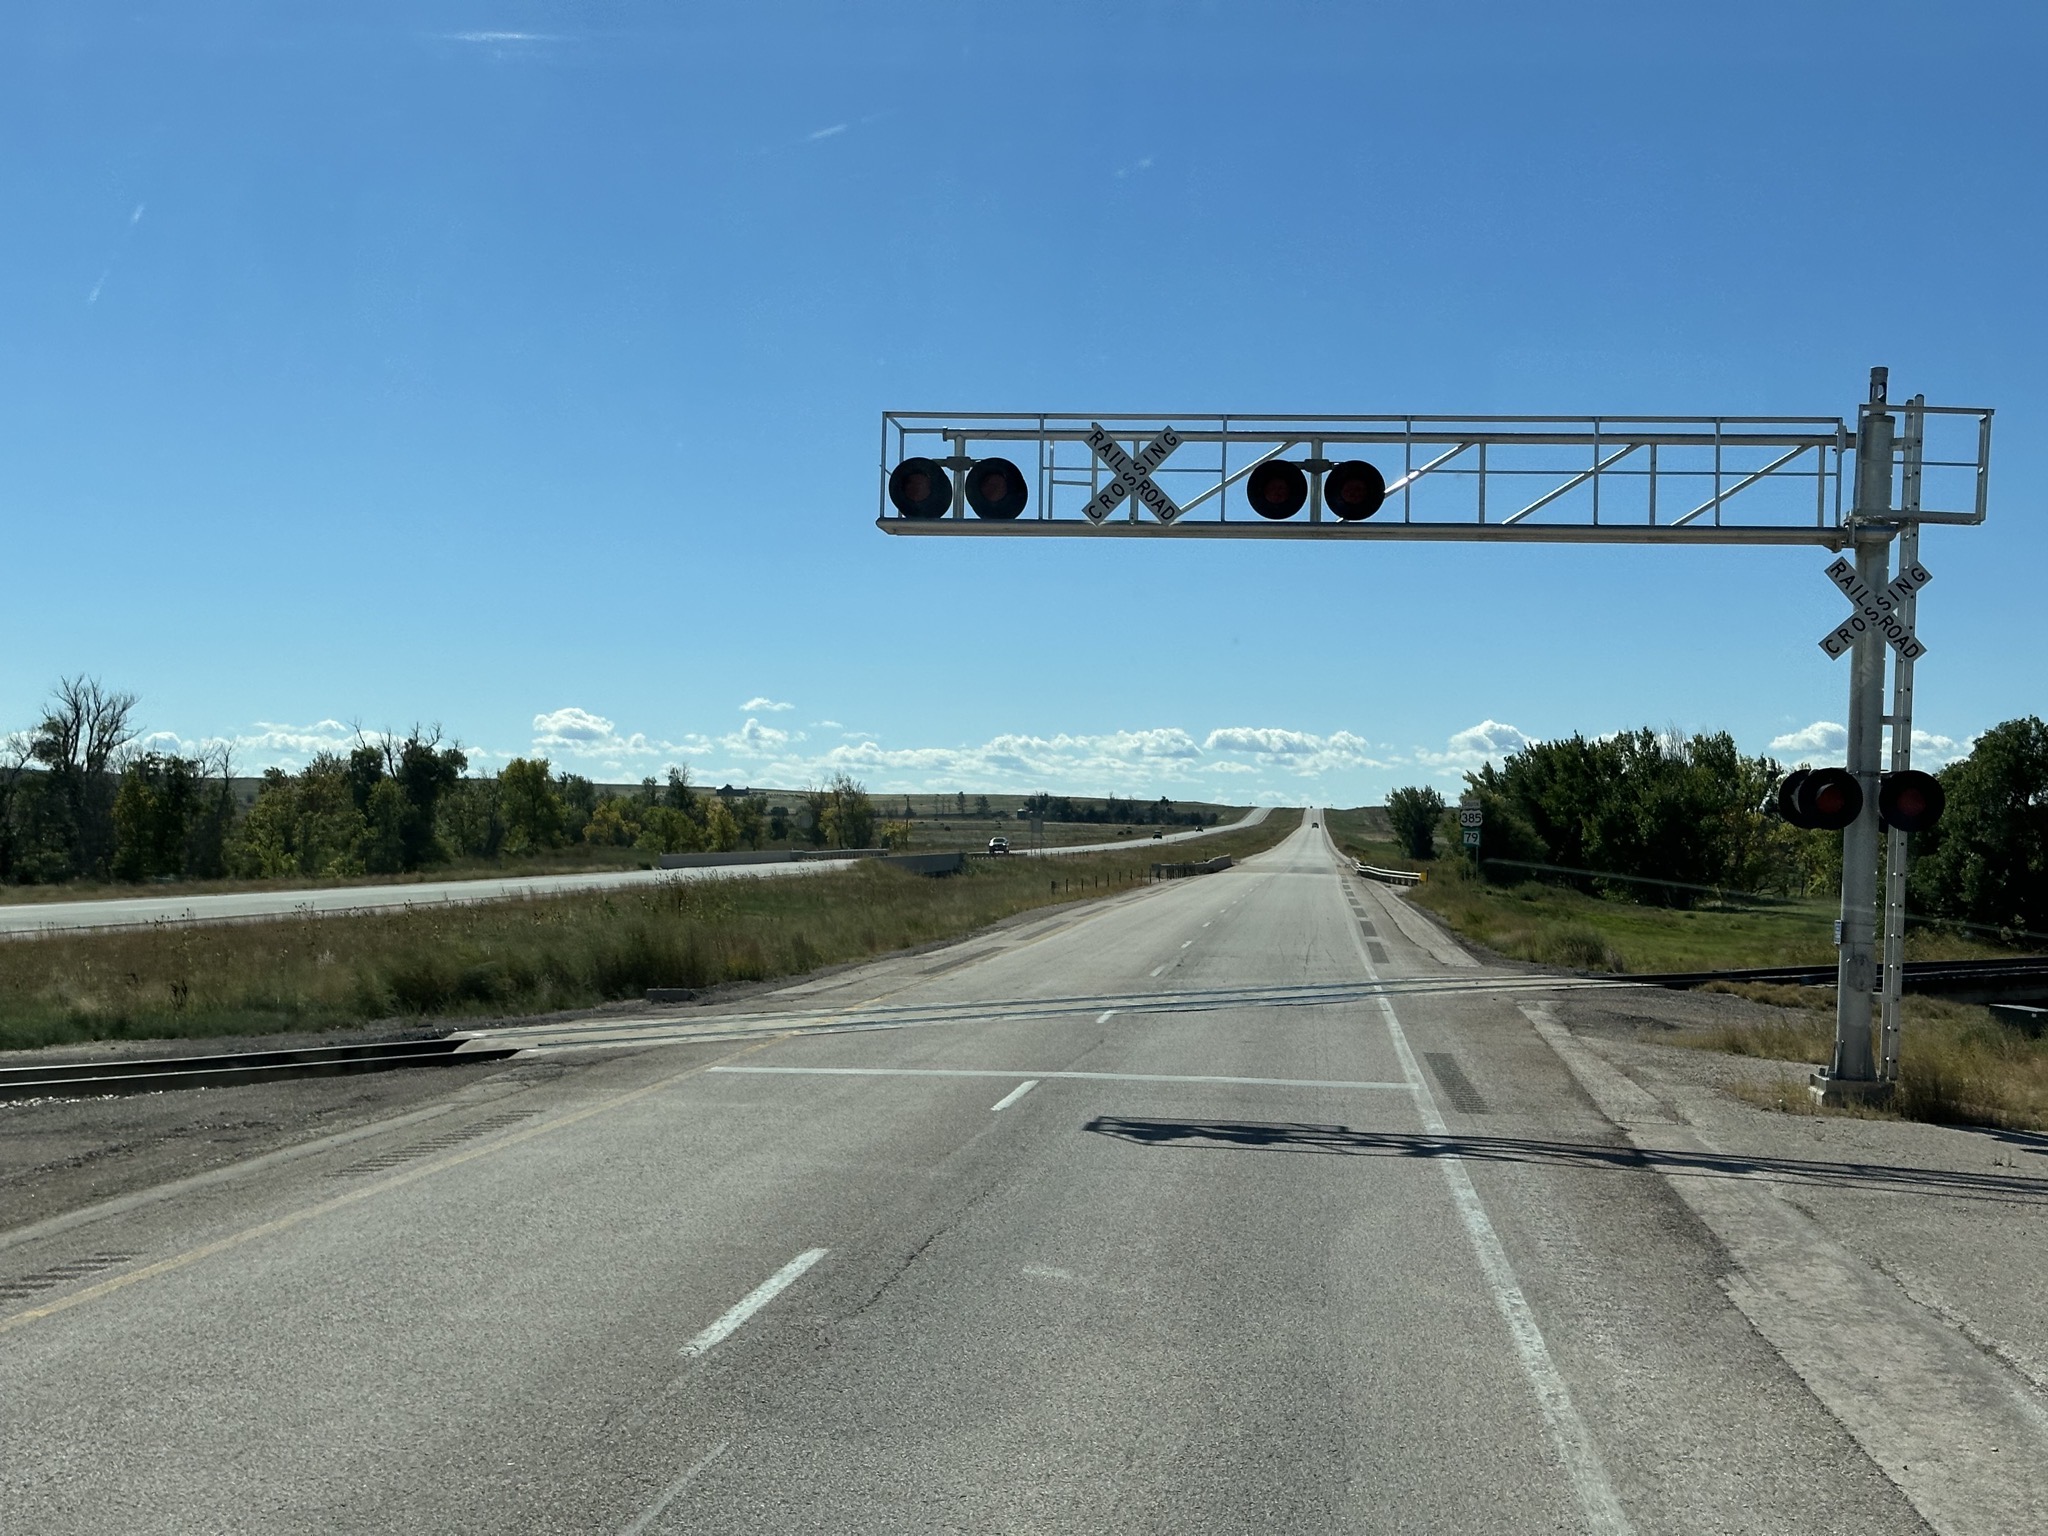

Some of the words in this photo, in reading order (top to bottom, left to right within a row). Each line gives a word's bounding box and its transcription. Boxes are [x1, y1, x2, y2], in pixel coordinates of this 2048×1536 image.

[1088, 432, 1177, 519] CROSSING
[1826, 567, 1925, 654] CROSSING
[1461, 812, 1482, 823] 385
[1465, 832, 1478, 843] 79
